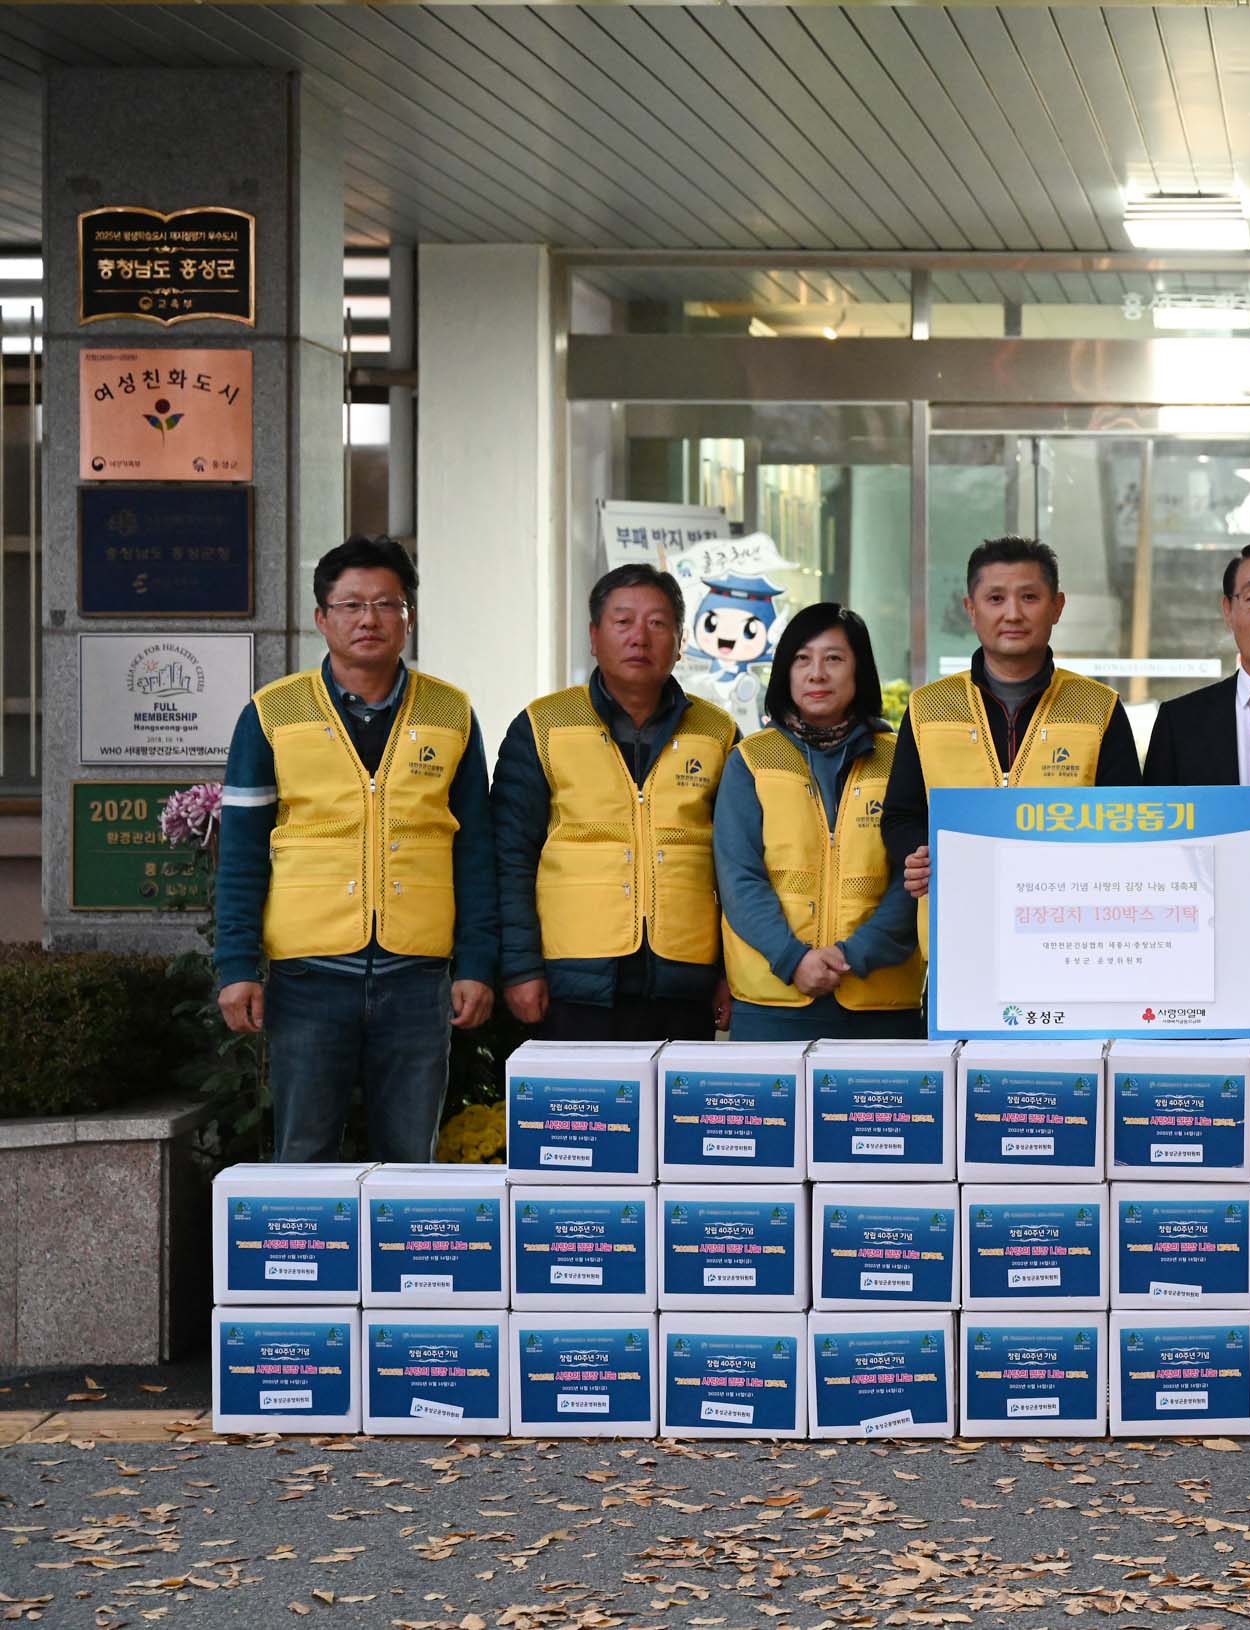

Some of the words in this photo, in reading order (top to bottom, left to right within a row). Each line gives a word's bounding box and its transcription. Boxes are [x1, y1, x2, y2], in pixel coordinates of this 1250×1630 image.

[97, 258, 171, 280] 충청남도
[179, 258, 236, 280] 홍성군
[94, 368, 240, 405] 여성친화도시
[616, 527, 649, 549] 부패
[154, 702, 178, 711] FULL
[134, 712, 198, 721] MEMBERSHIP
[100, 746, 122, 755] WHO
[90, 799, 148, 821] 2020
[1016, 802, 1195, 832] 이웃사랑돕기
[1016, 882, 1066, 892] 창립40주년
[1071, 882, 1088, 892] 기념
[1093, 882, 1120, 892] 사랑의
[1125, 882, 1143, 892] 김장
[1148, 882, 1165, 892] 나눔
[1171, 882, 1198, 892] 대축제
[1015, 905, 1081, 924] 김장김치
[1095, 905, 1153, 924] 130박스
[1165, 905, 1199, 924] 기탁
[1026, 1011, 1065, 1025] 홍성군
[1158, 1008, 1206, 1019] 사랑의열매
[853, 1095, 867, 1103] 창립
[867, 1095, 889, 1104] 40주년
[890, 1095, 903, 1104] 기념
[550, 1102, 563, 1111] 창립
[563, 1103, 585, 1112] 40주년
[586, 1103, 599, 1112] 기념
[848, 1112, 875, 1123] 사랑의
[544, 1119, 571, 1130] 사랑의
[267, 1222, 281, 1230] 창립
[281, 1222, 303, 1230] 40주년
[304, 1222, 317, 1230] 기념
[704, 1225, 718, 1234] 창립
[718, 1226, 740, 1234] 40주년
[741, 1226, 754, 1235] 기념
[1008, 1229, 1022, 1237] 창립
[1022, 1228, 1044, 1237] 40주년
[1045, 1228, 1059, 1237] 기념
[263, 1239, 290, 1250] 사랑의
[699, 1243, 726, 1253] 사랑의
[260, 1347, 273, 1356] 창립
[273, 1347, 295, 1356] 40주년
[296, 1347, 309, 1356] 기념
[1159, 1352, 1173, 1361] 창립
[1173, 1351, 1195, 1360] 40주년
[1196, 1351, 1209, 1360] 기념
[560, 1354, 574, 1362] 창립
[574, 1354, 596, 1362] 40주년
[596, 1354, 610, 1362] 기념
[556, 1371, 582, 1382] 사랑의
[1155, 1369, 1182, 1380] 사랑의
